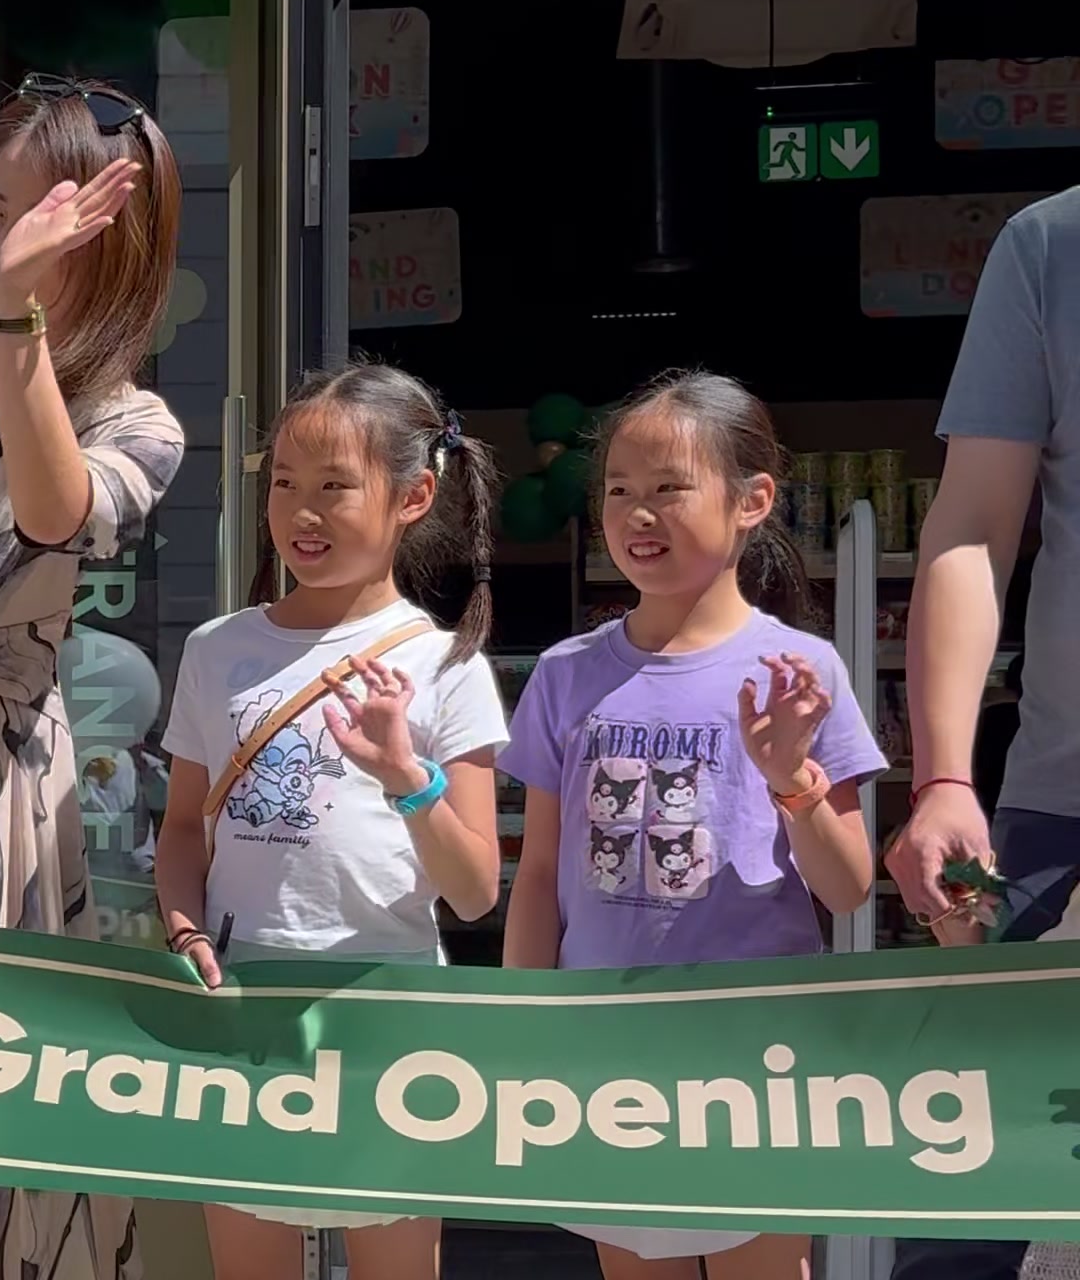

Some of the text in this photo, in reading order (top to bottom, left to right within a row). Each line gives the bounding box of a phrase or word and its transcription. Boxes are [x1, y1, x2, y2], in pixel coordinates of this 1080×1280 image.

[582, 722, 722, 767] KUROMI
[266, 832, 311, 849] family
[374, 1043, 996, 1175] Opening
